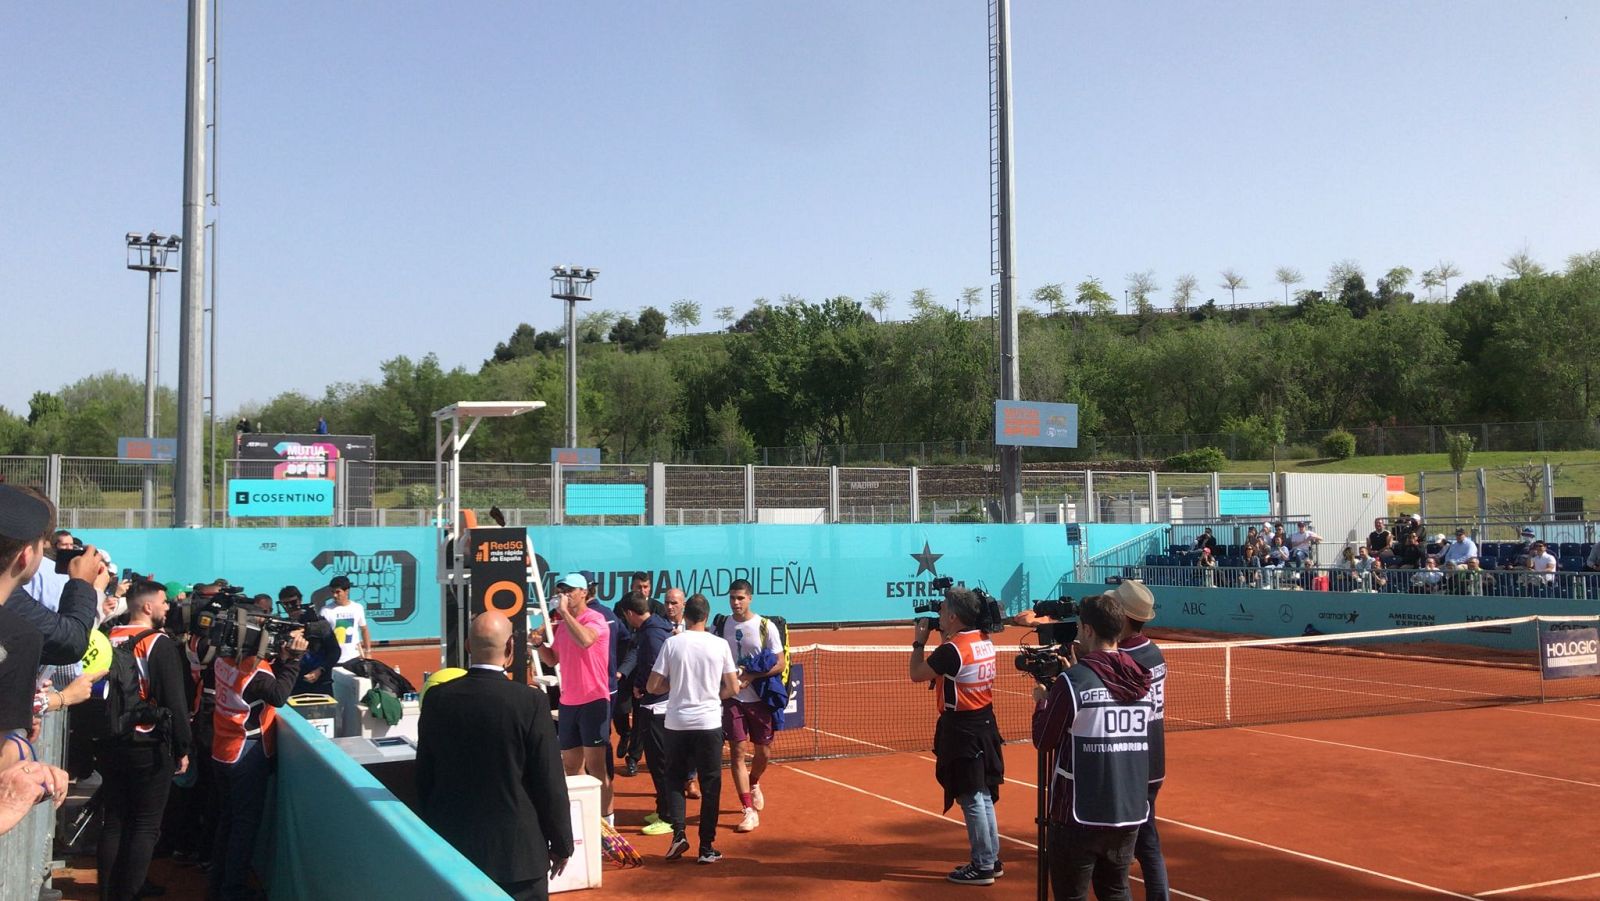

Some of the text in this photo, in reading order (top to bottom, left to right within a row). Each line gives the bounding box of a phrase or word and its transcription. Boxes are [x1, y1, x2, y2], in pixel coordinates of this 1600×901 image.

[287, 445, 326, 456] MUTUA
[850, 481, 879, 489] MADRID
[252, 493, 325, 503] COSENTINO
[475, 541, 489, 562] #1
[333, 555, 395, 572] MUTUA
[1182, 602, 1206, 616] ABC
[1388, 612, 1435, 621] AMERICAN
[1546, 640, 1597, 657] HOLOGIC
[1104, 709, 1146, 734] 003
